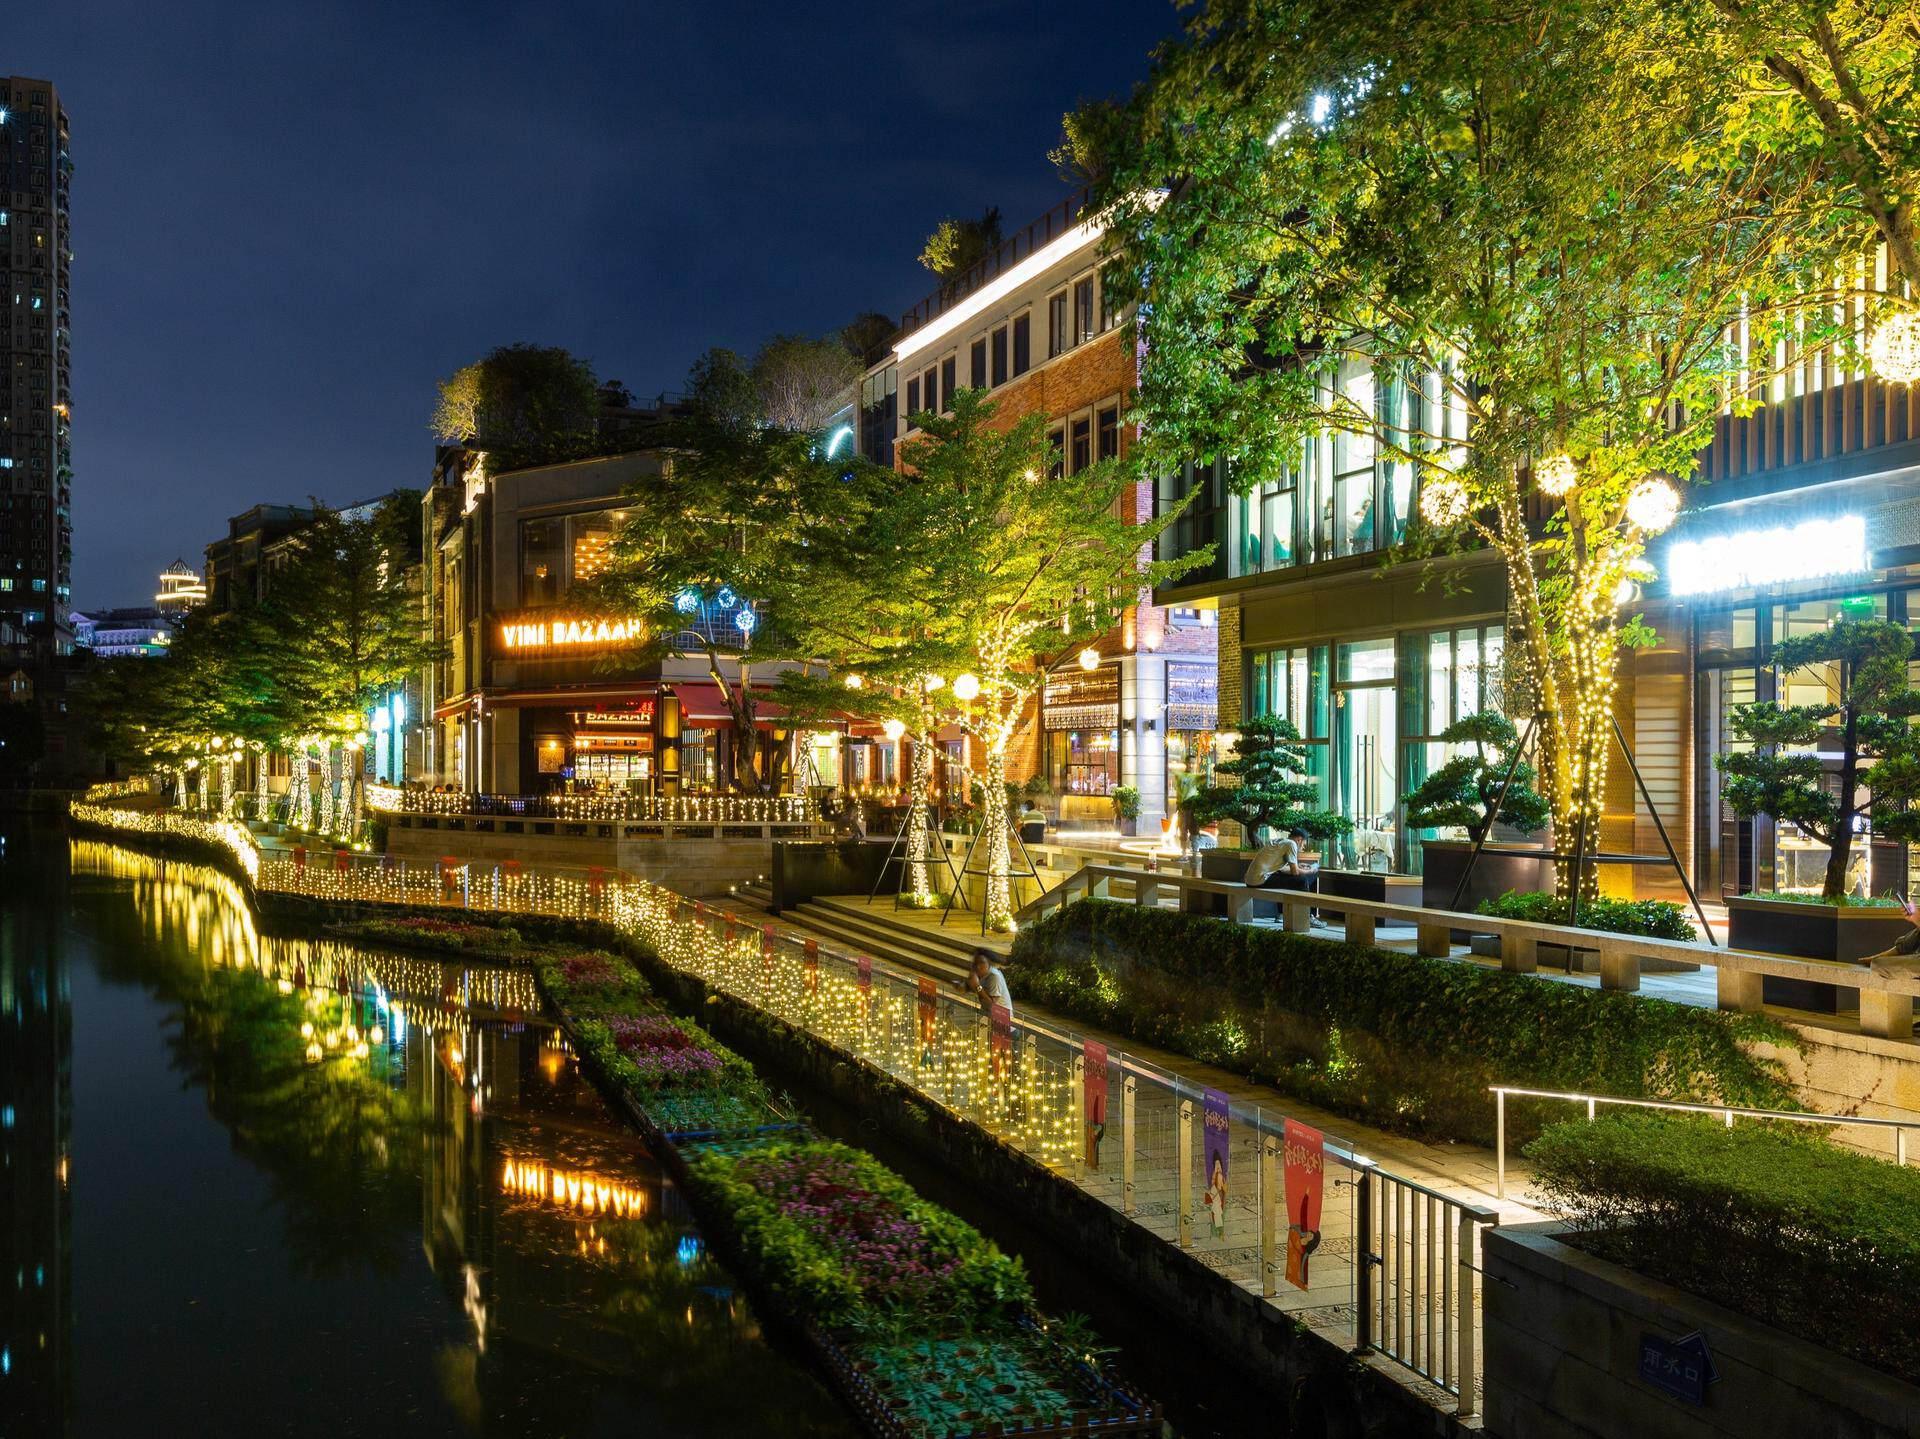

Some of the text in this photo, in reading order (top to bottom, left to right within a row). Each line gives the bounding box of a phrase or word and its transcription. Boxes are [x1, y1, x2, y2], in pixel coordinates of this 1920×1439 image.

[503, 618, 640, 647] VINI BAZAAR
[1643, 1346, 1699, 1383] 雨水口
